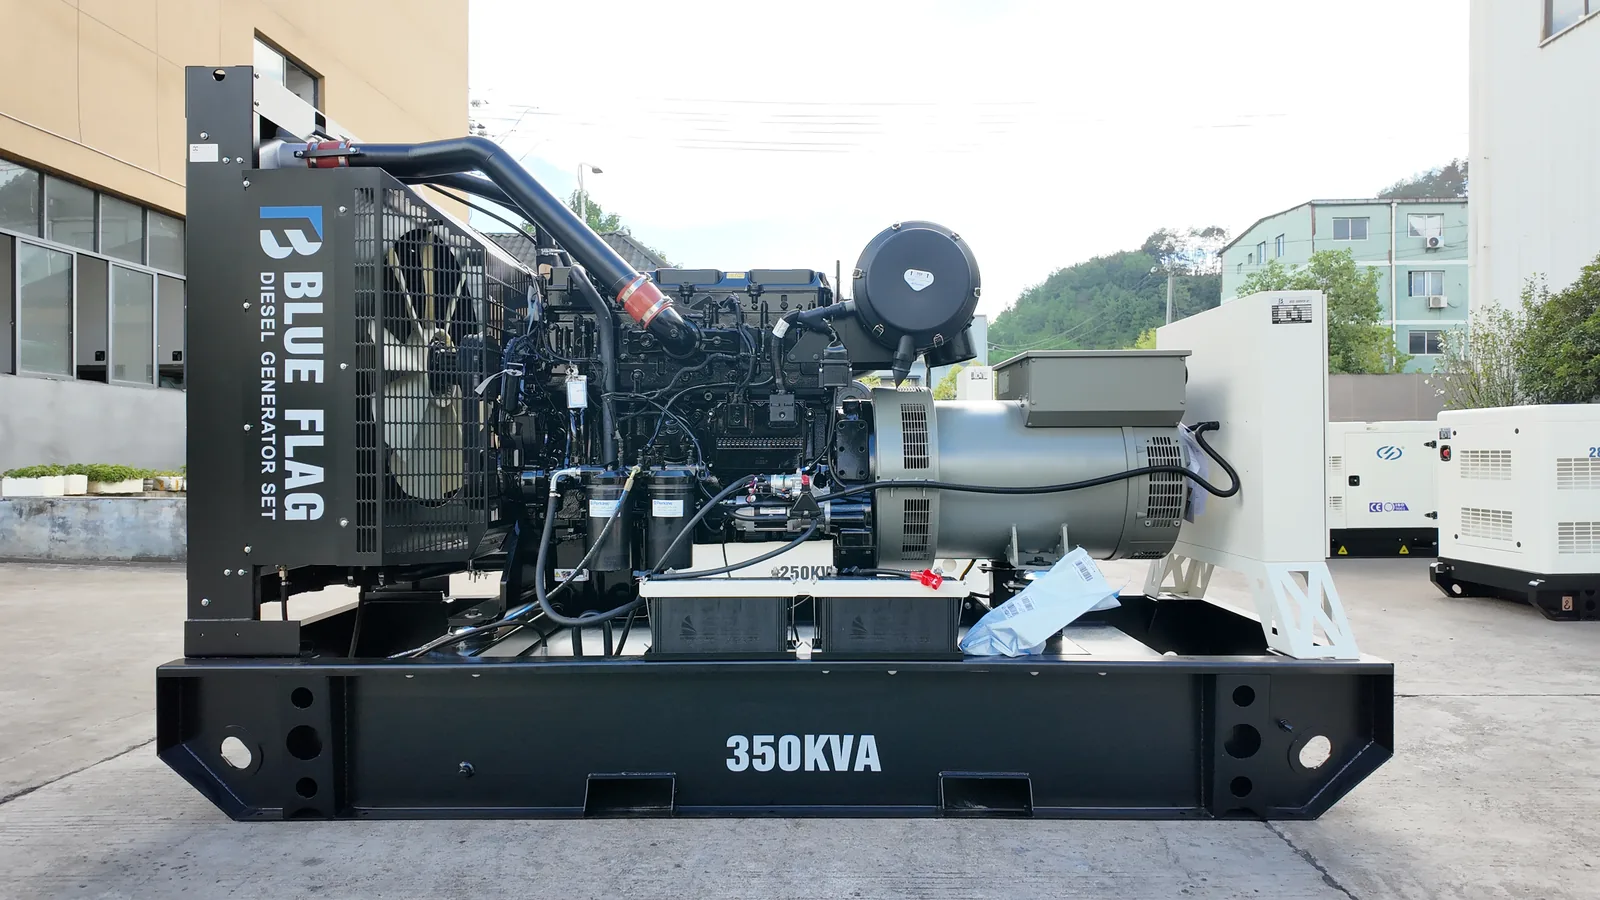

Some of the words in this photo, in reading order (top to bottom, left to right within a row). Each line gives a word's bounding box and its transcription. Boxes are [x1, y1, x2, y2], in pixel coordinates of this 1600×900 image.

[260, 272, 276, 342] DIESEL
[283, 271, 324, 384] BLUE
[260, 351, 277, 474] GENERATOR
[283, 409, 325, 521] FLAG
[260, 482, 276, 521] SET
[780, 565, 832, 581] 250KV
[726, 734, 882, 772] 350KVA
